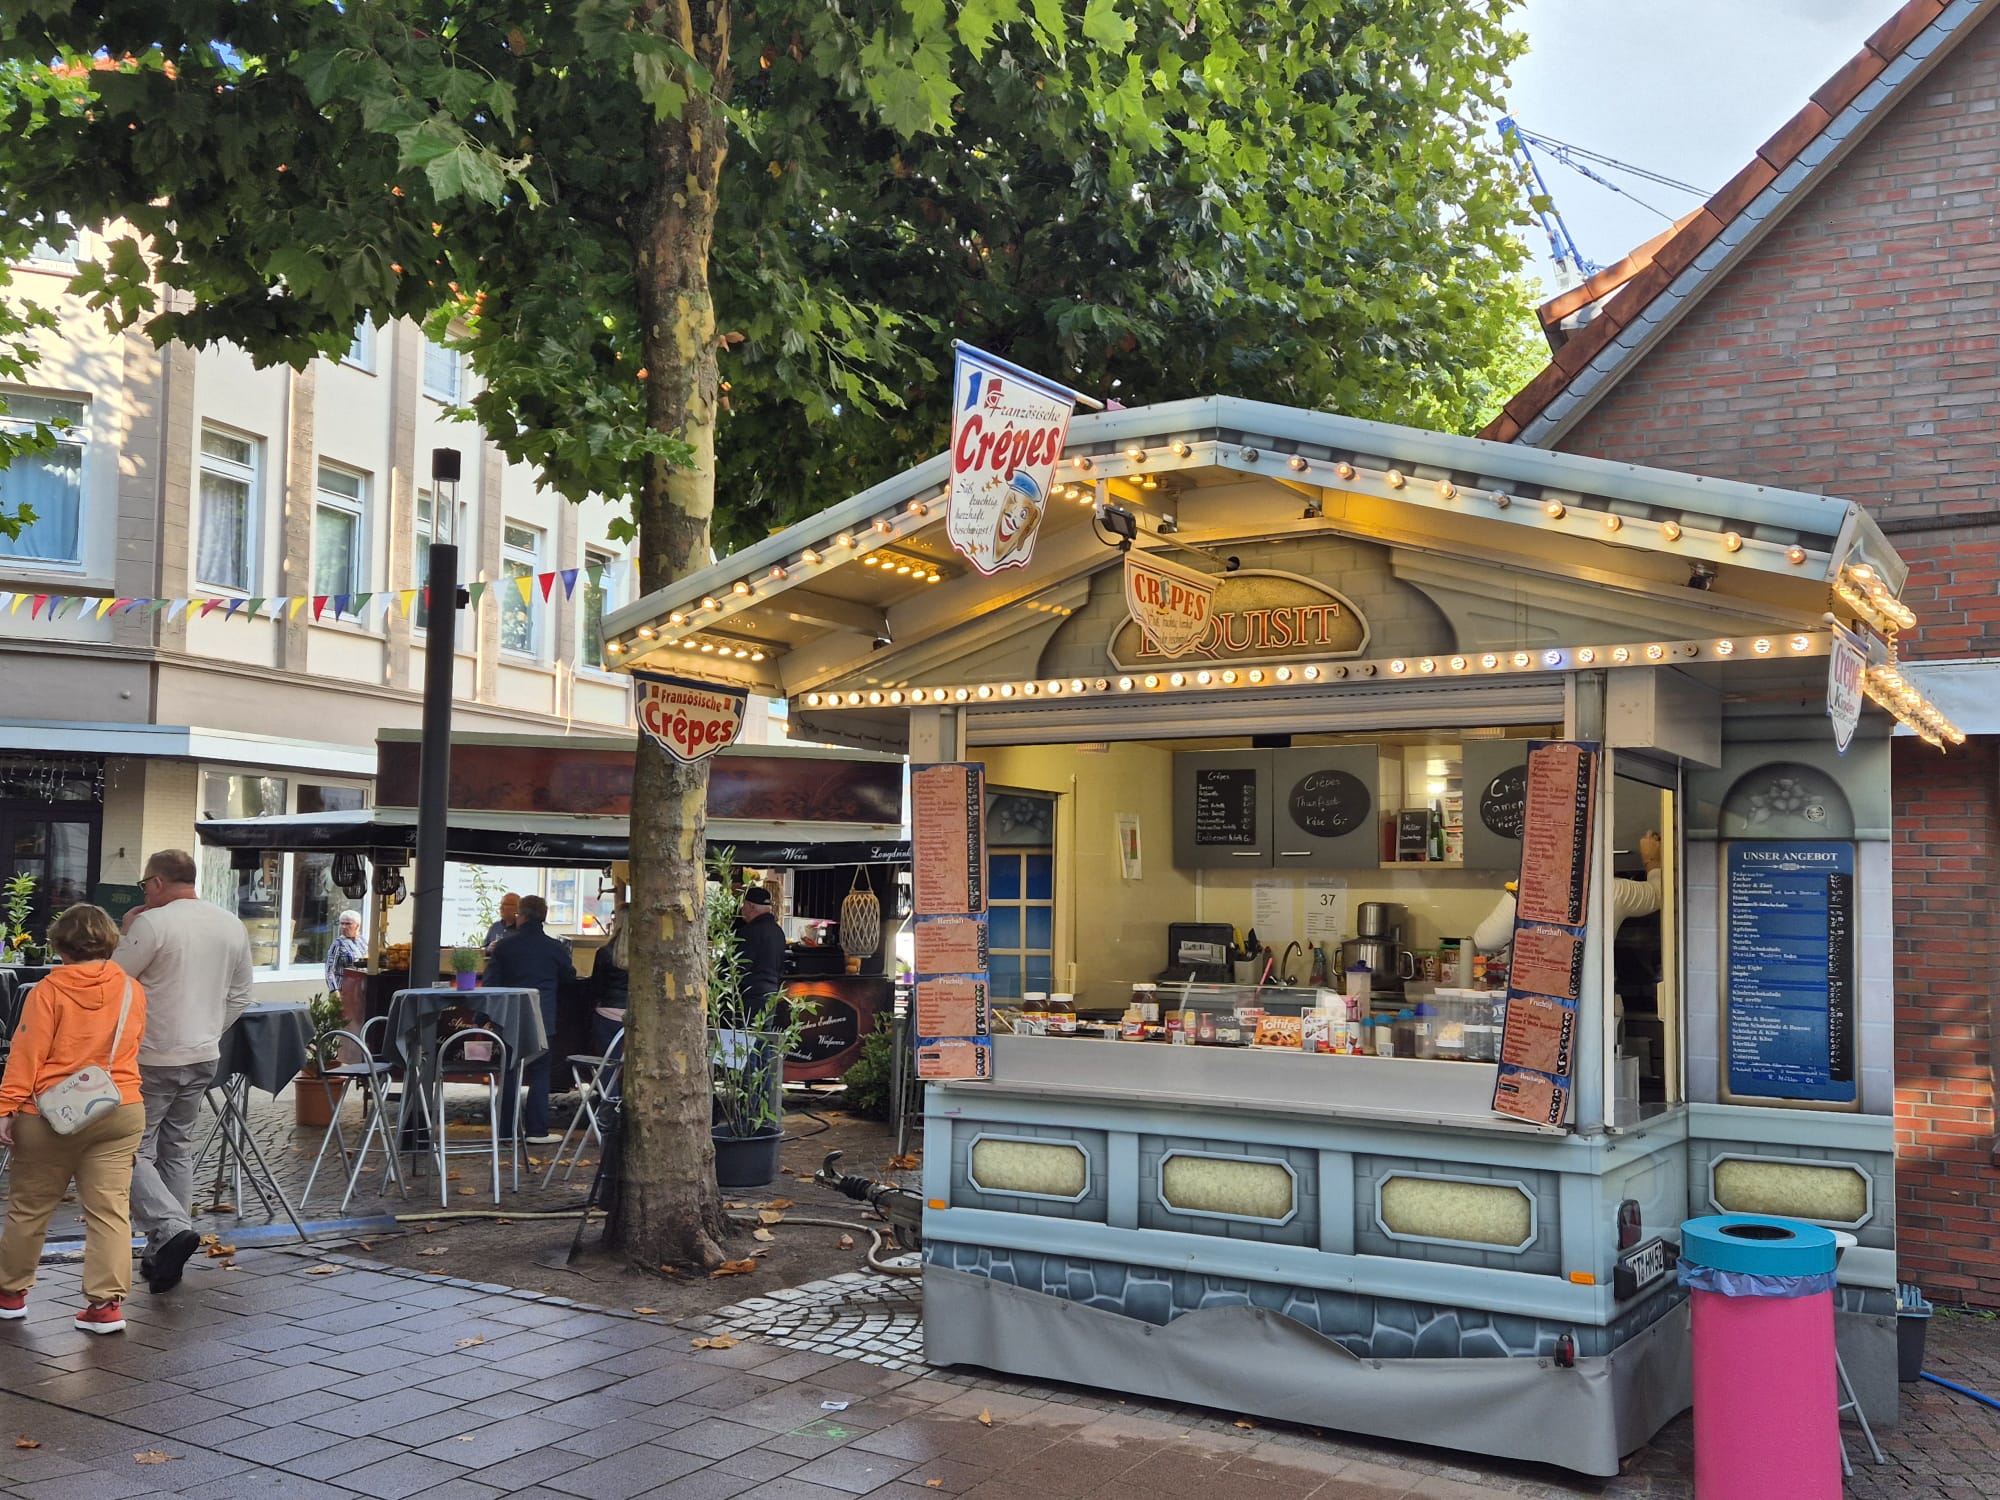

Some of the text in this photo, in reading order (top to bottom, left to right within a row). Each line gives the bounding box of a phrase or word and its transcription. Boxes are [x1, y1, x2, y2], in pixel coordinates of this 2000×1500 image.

[956, 415, 1060, 480] Crêpes
[1136, 603, 1340, 660] QUISIT
[661, 688, 722, 712] Französische
[645, 701, 734, 755] Crêpes
[508, 840, 549, 856] Kaffee
[781, 848, 808, 860] Wein
[1743, 852, 1838, 861] UNSER ANGEBOT
[1320, 894, 1336, 906] 37
[1261, 1018, 1301, 1031] Toffifee
